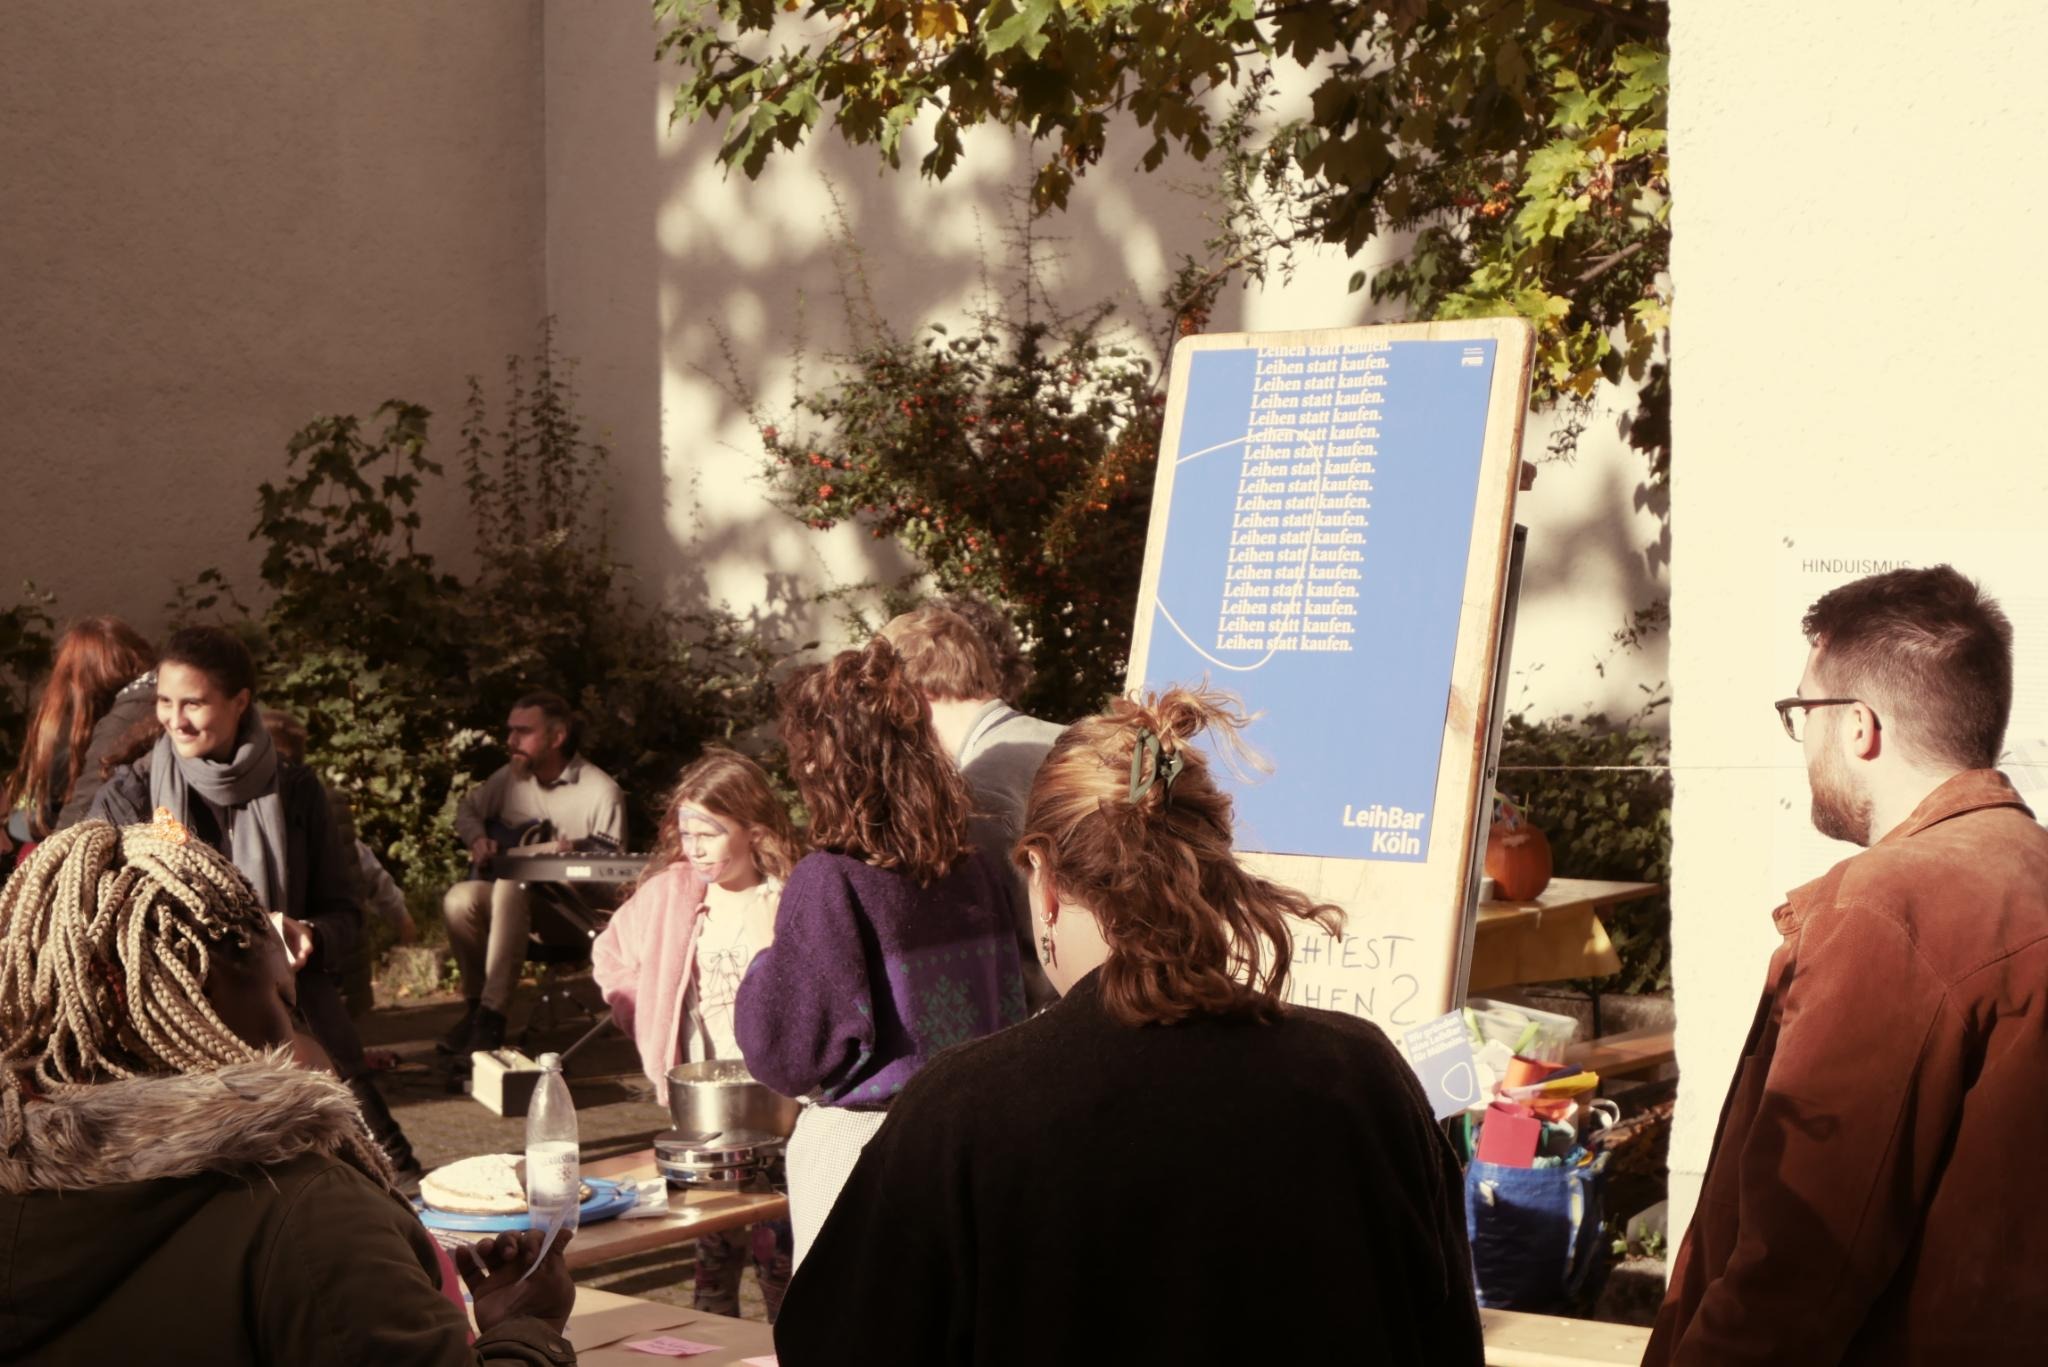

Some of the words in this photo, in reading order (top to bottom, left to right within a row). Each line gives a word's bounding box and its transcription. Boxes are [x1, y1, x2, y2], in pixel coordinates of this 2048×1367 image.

[1256, 359, 1303, 374] Leihen
[1307, 358, 1337, 372] statt
[1341, 353, 1388, 369] kaufen.
[1254, 376, 1300, 391] Leihen
[1305, 375, 1334, 389] statt
[1339, 371, 1386, 386] kaufen.
[1251, 393, 1297, 408] Leihen
[1302, 392, 1332, 406] statt
[1336, 388, 1384, 403] kaufen.
[1249, 410, 1295, 425] Leihen
[1300, 409, 1329, 423] statt
[1334, 405, 1381, 421] kaufen.
[1247, 427, 1292, 442] Leihen
[1298, 426, 1327, 440] statt
[1332, 423, 1379, 438] kaufen.
[1244, 444, 1289, 459] Leihen
[1295, 443, 1324, 457] statt
[1329, 440, 1376, 455] kaufen.
[1241, 461, 1286, 476] Leihen
[1292, 461, 1322, 474] statt
[1326, 458, 1374, 472] kaufen.
[1239, 479, 1284, 493] Leihen
[1289, 478, 1319, 491] statt
[1323, 475, 1372, 490] kaufen.
[1236, 496, 1281, 511] Leihen
[1285, 496, 1316, 510] statt
[1319, 493, 1370, 508] kaufen.
[1234, 513, 1279, 528] Leihen
[1283, 513, 1314, 527] statt
[1317, 510, 1367, 526] kaufen.
[1231, 530, 1276, 545] Leihen
[1280, 530, 1311, 544] statt
[1314, 528, 1365, 543] kaufen.
[1229, 548, 1274, 562] Leihen
[1278, 548, 1309, 562] statt
[1312, 546, 1363, 561] kaufen.
[1226, 565, 1272, 580] Leihen
[1275, 566, 1306, 579] statt
[1310, 563, 1361, 578] kaufen.
[1224, 583, 1269, 597] Leihen
[1273, 583, 1303, 597] statt
[1307, 581, 1359, 596] kaufen.
[1221, 600, 1267, 615] Leihen
[1270, 601, 1301, 615] statt
[1305, 599, 1356, 614] kaufen.
[1219, 618, 1265, 632] Leihen
[1268, 618, 1298, 632] statt
[1302, 617, 1354, 632] kaufen.
[1216, 635, 1262, 650] Leihen
[1265, 636, 1296, 650] statt
[1300, 635, 1352, 650] kaufen.
[1343, 805, 1424, 830] LeihBar
[1372, 831, 1420, 855] Köln
